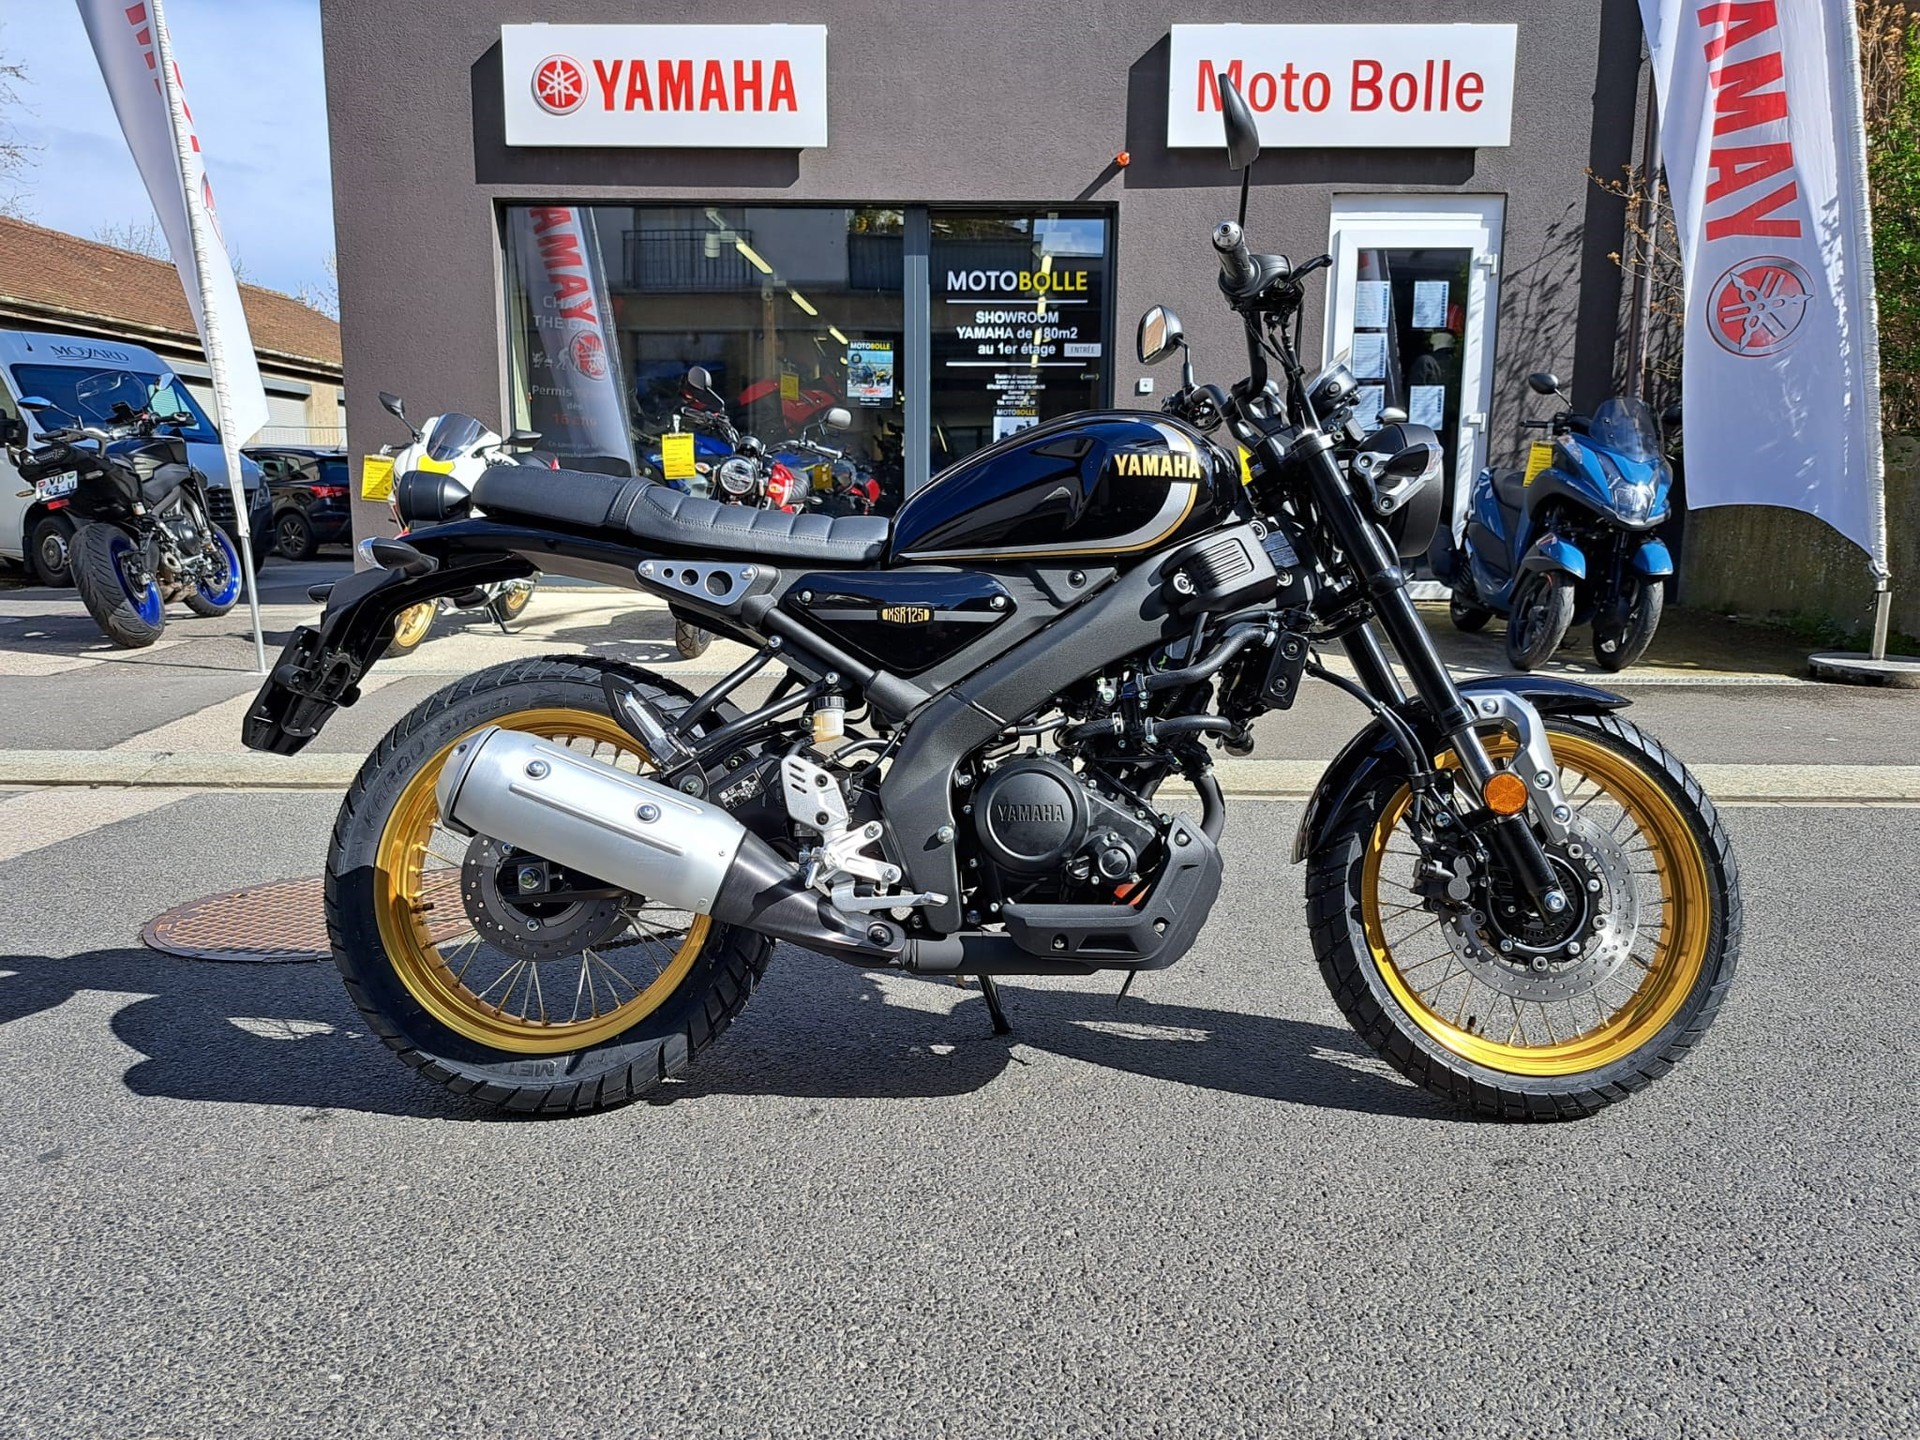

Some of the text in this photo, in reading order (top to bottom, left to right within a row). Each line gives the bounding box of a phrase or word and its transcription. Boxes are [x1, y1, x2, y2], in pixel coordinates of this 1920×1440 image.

[593, 59, 798, 112] YAMAHA
[1197, 59, 1484, 113] Moto Bolle
[946, 270, 1088, 291] MOTOBOLLE
[533, 314, 563, 329] THE
[975, 311, 1059, 323] SHOWROOM
[956, 327, 1014, 339] YAMAHA
[1017, 327, 1032, 339] de
[50, 345, 131, 364] MOYARD
[978, 342, 1056, 357] au 1er étage
[532, 385, 572, 397] Permis
[1114, 454, 1201, 479] YAMAHA
[49, 475, 65, 486] VD
[888, 606, 924, 624] XSR125
[997, 804, 1065, 822] YAMAHA
